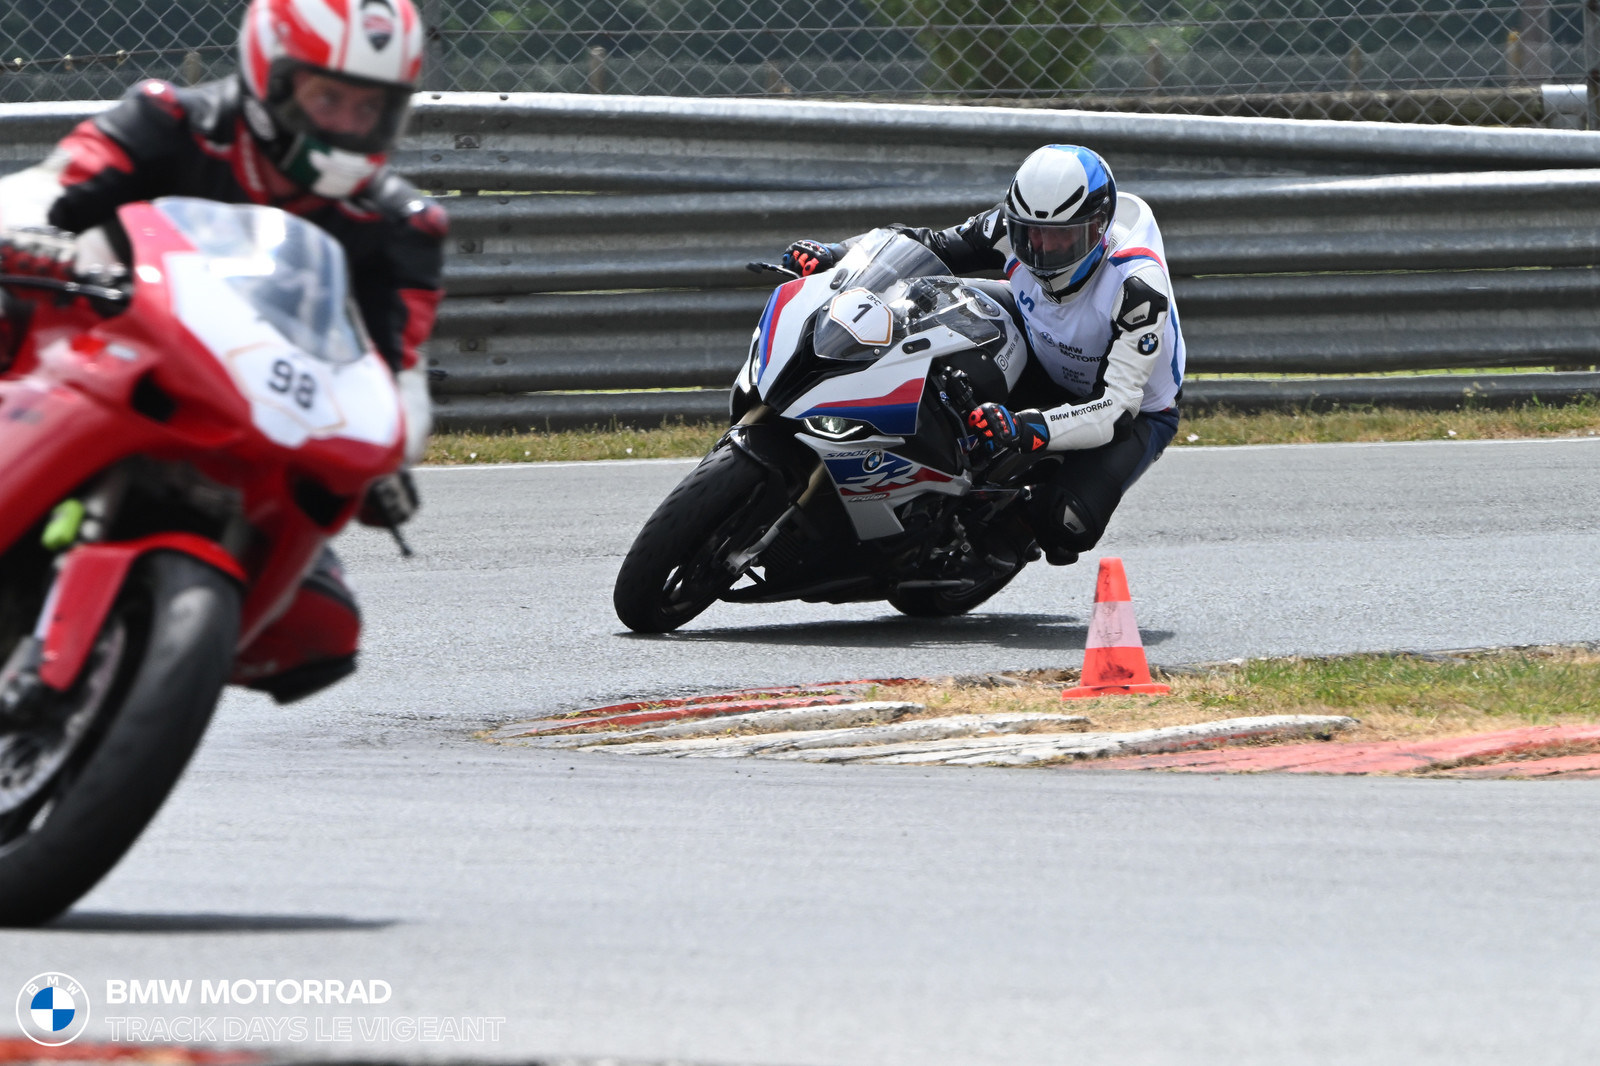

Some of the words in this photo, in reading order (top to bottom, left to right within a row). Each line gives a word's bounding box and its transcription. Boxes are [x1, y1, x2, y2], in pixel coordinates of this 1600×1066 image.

[852, 303, 873, 323] 1
[1058, 341, 1083, 354] BMW
[1060, 348, 1102, 362] MOTORR
[268, 360, 317, 410] 98
[1049, 412, 1070, 422] BMW
[1070, 398, 1113, 418] MOTORRAD
